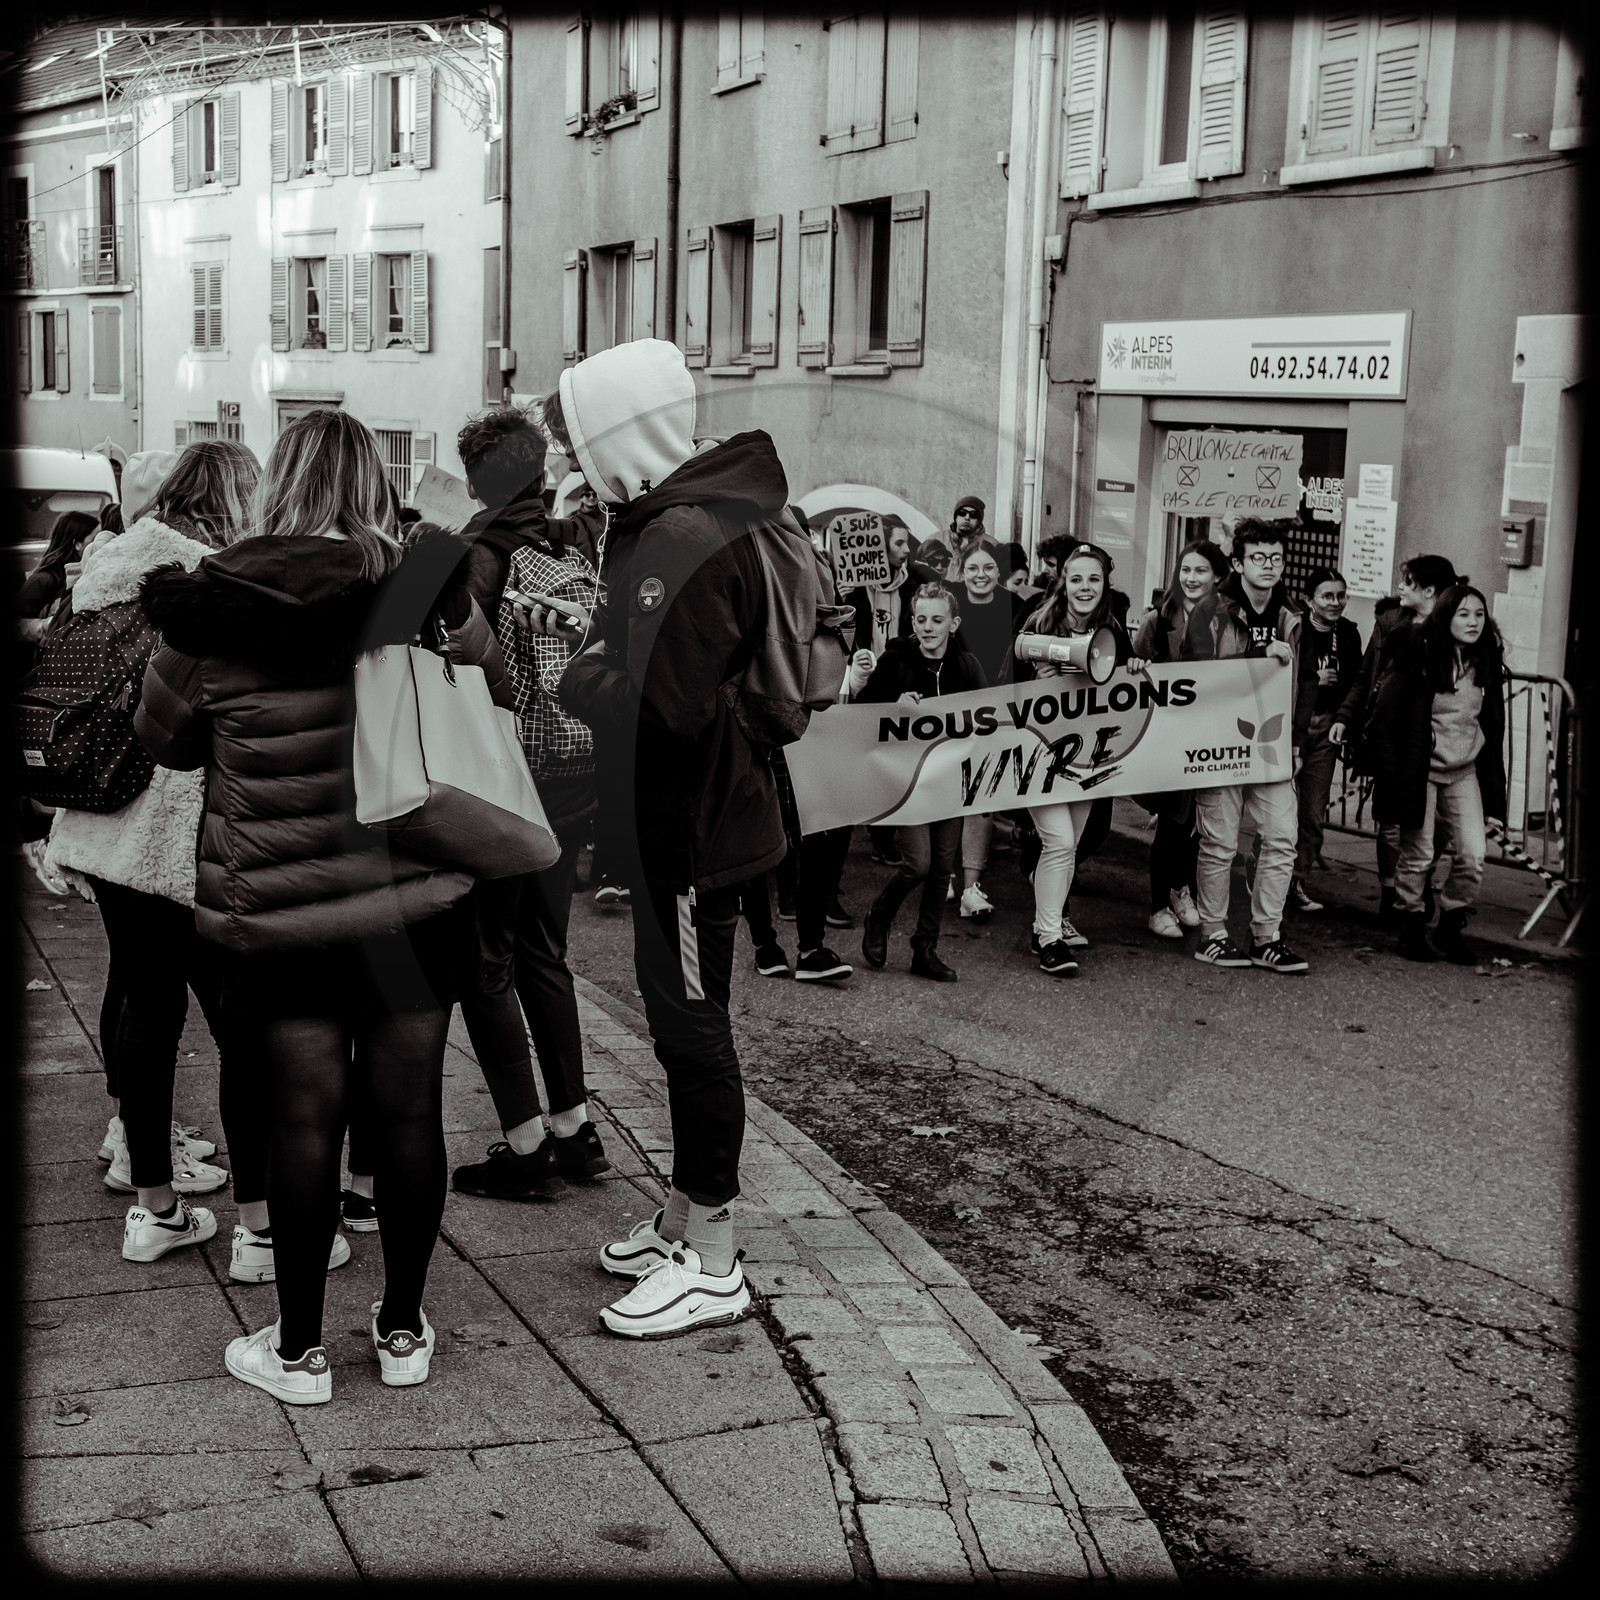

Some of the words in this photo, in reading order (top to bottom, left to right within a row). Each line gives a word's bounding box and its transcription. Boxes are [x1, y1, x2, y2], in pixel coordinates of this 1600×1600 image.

[1131, 335, 1174, 353] ALPES
[1131, 354, 1173, 370] INTERIM
[1250, 355, 1390, 379] 04.92.54.74.02
[229, 404, 238, 417] P
[1167, 435, 1233, 462] BRULONS
[1232, 440, 1253, 460] LE
[1163, 491, 1190, 507] PAS
[1195, 491, 1229, 507] LE
[1225, 493, 1292, 509] PETROLE
[839, 532, 881, 550] ÉCOLO
[878, 706, 999, 742] NOUS
[1006, 679, 1197, 729] VOULONS
[1184, 745, 1251, 763] YOUTH
[960, 725, 1125, 807] VIVRE
[1183, 765, 1205, 774] FOR
[1207, 761, 1251, 772] CLIMATE
